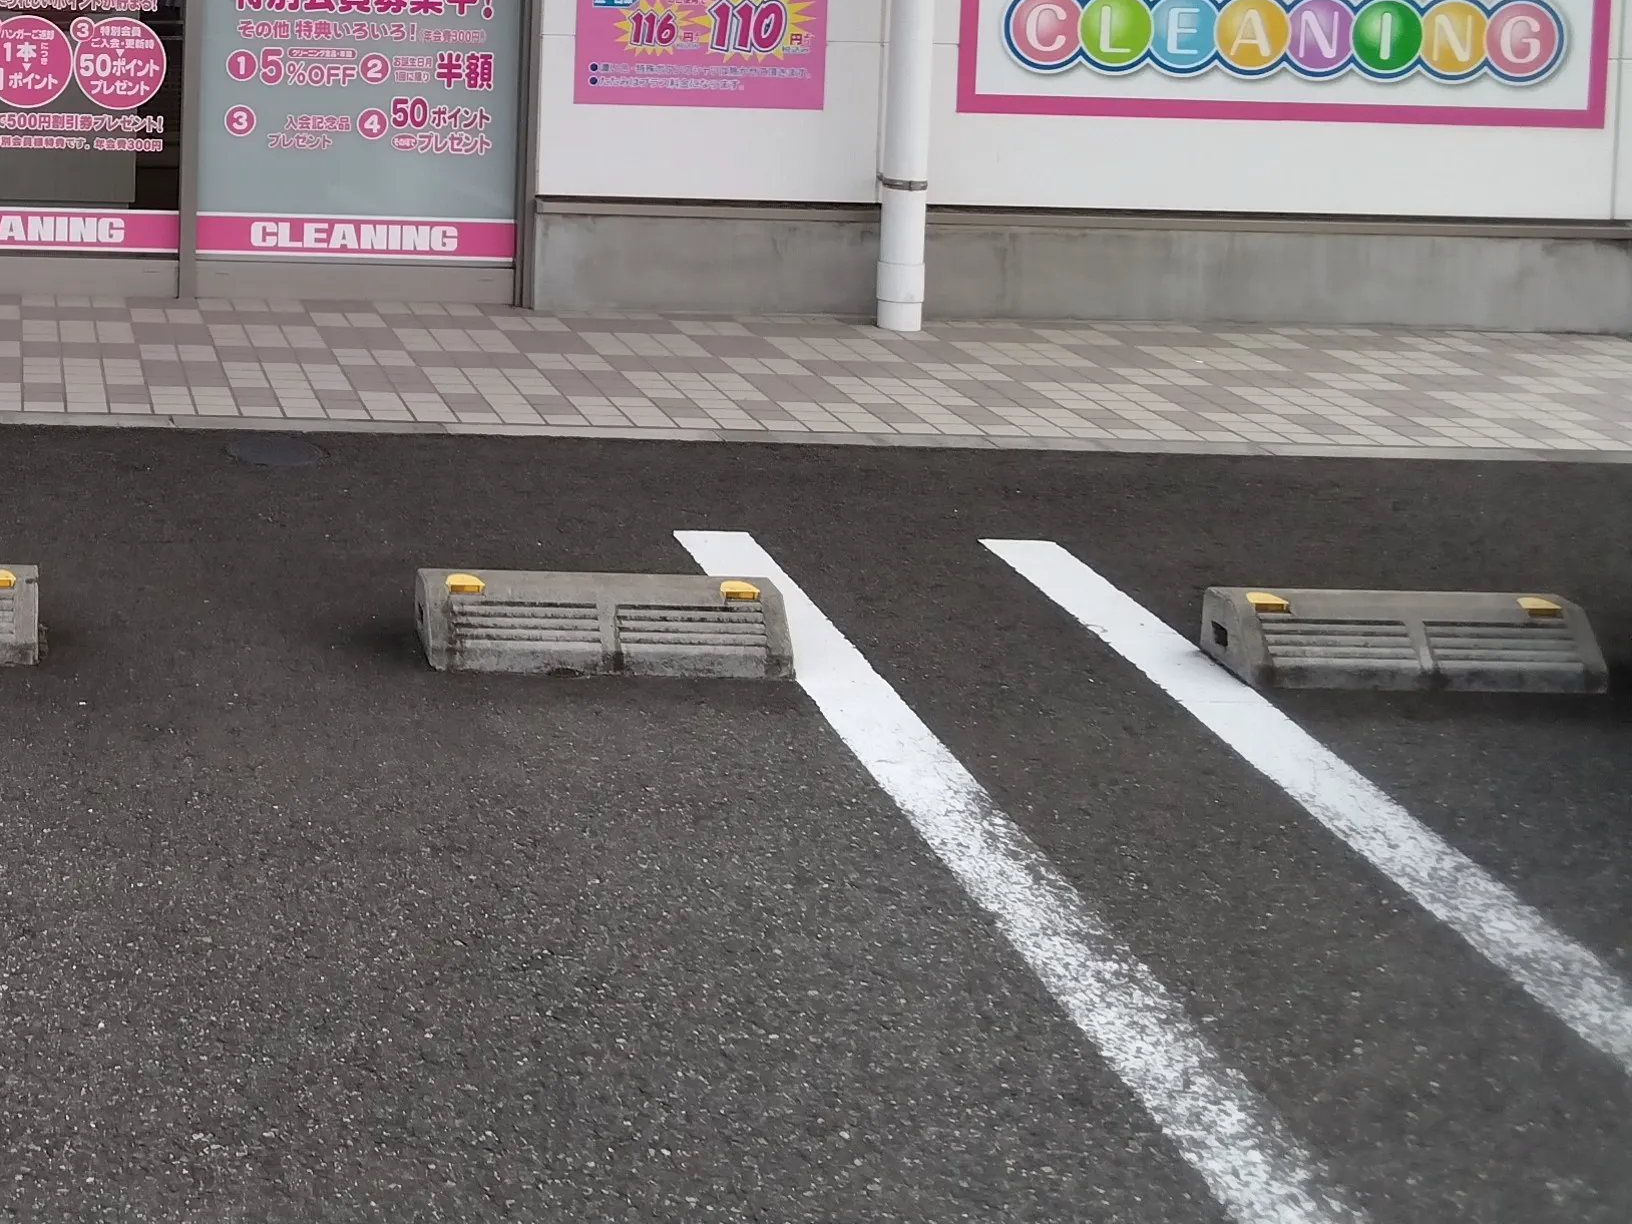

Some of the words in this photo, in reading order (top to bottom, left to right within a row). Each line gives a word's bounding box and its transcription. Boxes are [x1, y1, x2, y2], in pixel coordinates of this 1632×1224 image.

[99, 26, 142, 37] 特別会員
[238, 19, 291, 40] その他
[79, 53, 160, 77] 50ポイント
[434, 50, 495, 91] 半額
[90, 79, 150, 96] プレゼント
[284, 114, 351, 132] 入会記念品
[267, 133, 333, 150] プレゼント
[417, 131, 492, 155] プレゼント
[250, 220, 458, 252] CLEANING
